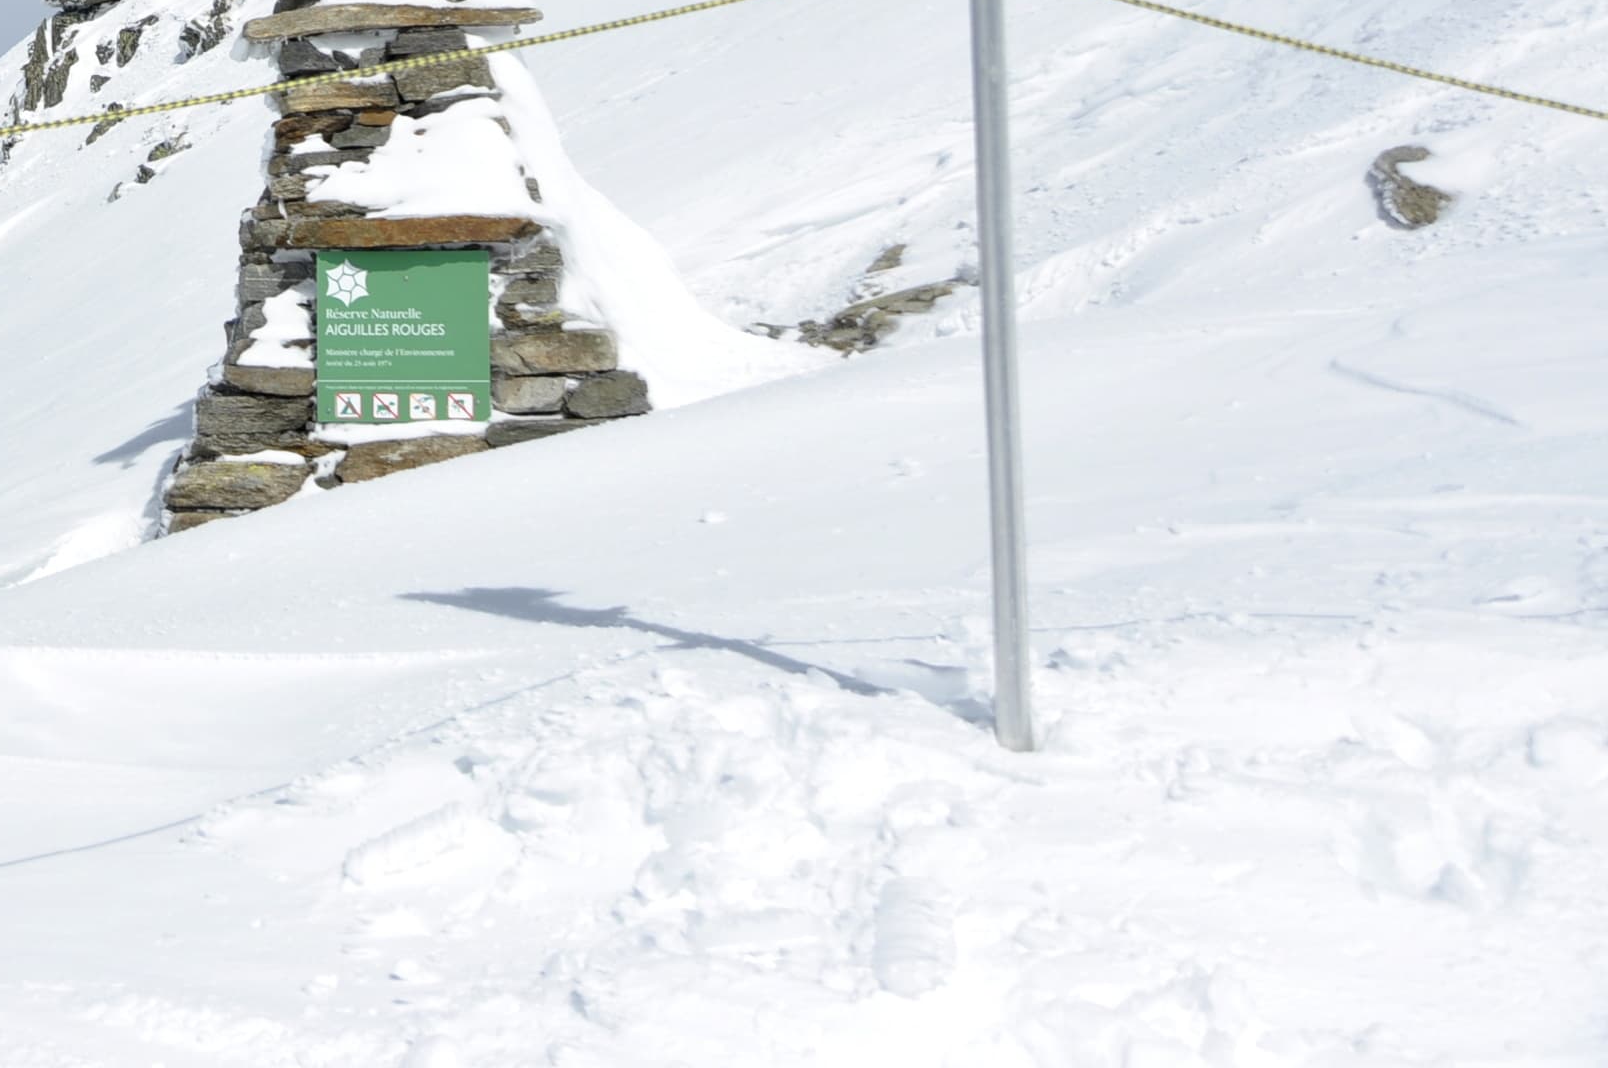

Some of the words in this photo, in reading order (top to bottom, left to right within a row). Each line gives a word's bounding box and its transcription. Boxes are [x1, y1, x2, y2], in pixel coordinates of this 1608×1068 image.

[325, 308, 369, 319] Réserve
[371, 308, 423, 319] Naturelle
[325, 323, 389, 336] AIGUILLES
[392, 323, 446, 336] ROUGES
[384, 348, 393, 356] de
